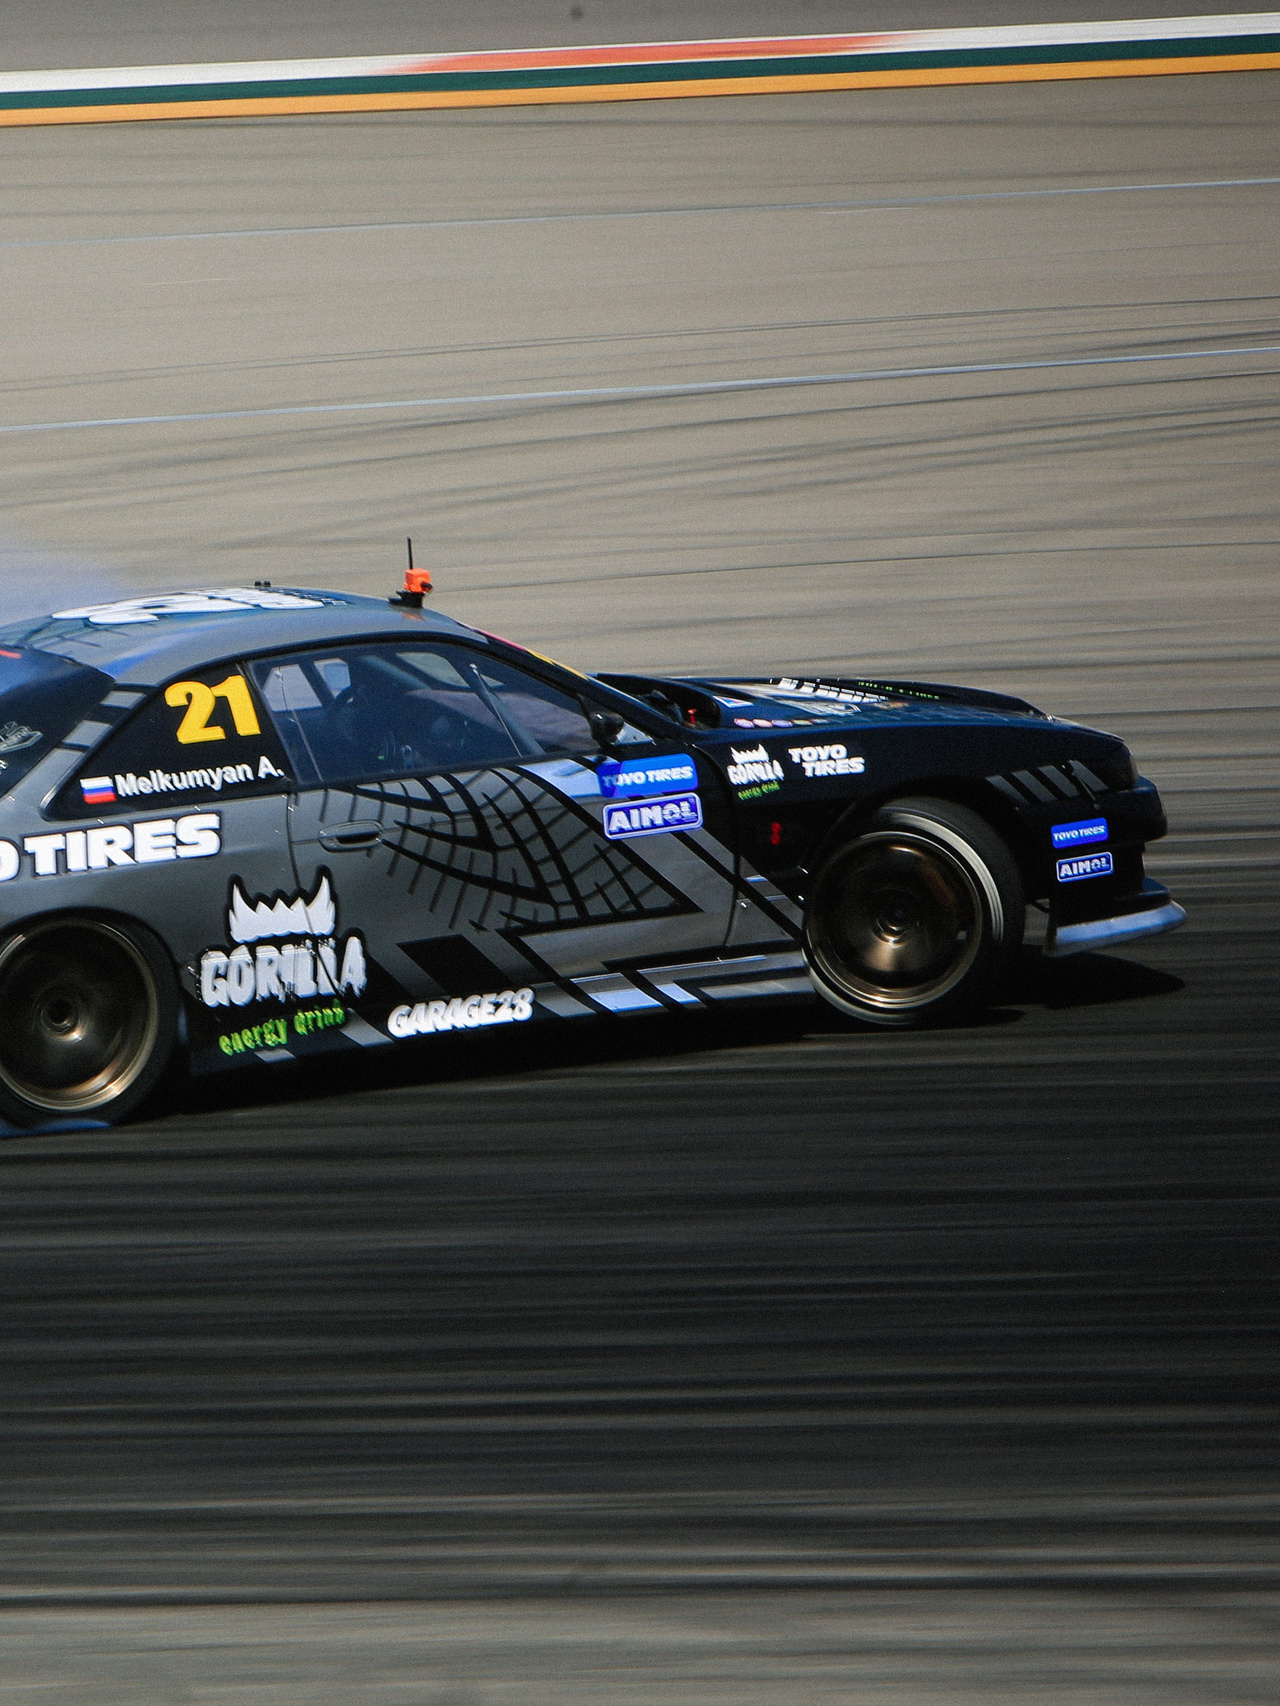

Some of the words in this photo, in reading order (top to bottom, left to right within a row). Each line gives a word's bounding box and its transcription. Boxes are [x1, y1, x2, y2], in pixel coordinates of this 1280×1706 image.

[165, 674, 261, 744] 21
[788, 743, 848, 764] TOYO
[802, 756, 866, 778] TIRES
[114, 763, 255, 798] Melkumyan
[257, 755, 286, 779] A.
[602, 770, 646, 788] TOYO
[646, 765, 694, 783] TIRES
[23, 812, 221, 877] TIRES
[1053, 829, 1079, 842] TOYO
[1078, 825, 1106, 838] TIRES
[200, 935, 368, 1008] GORILLA
[387, 987, 536, 1039] GARAGE28
[218, 1018, 289, 1057] energy
